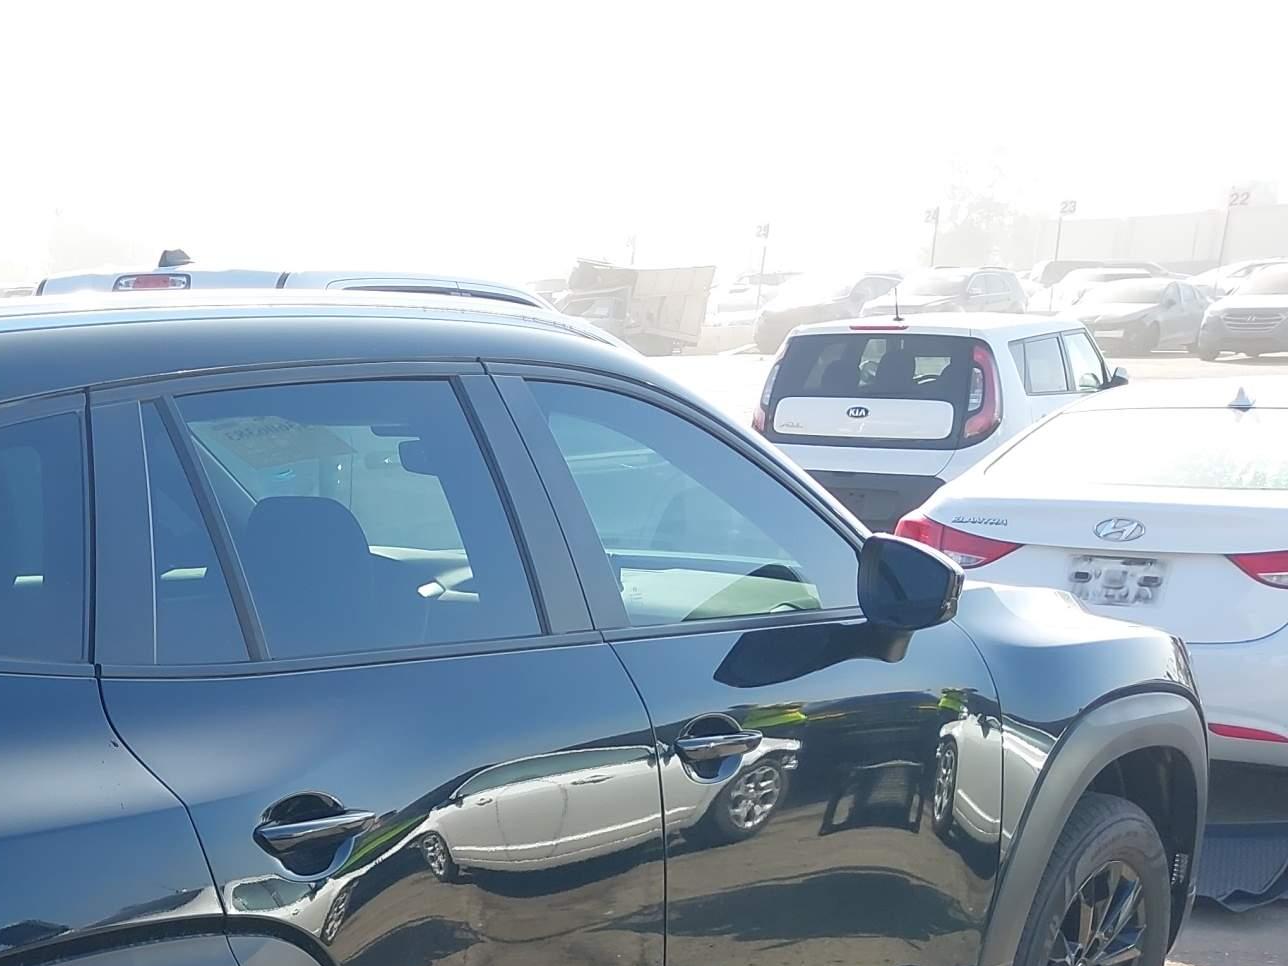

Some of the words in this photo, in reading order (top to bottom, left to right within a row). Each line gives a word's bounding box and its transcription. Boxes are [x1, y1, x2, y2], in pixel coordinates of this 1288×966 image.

[1228, 191, 1251, 207] 22
[1059, 200, 1078, 214] 23
[848, 408, 867, 417] KIA
[951, 515, 1009, 527] ELANTRA
